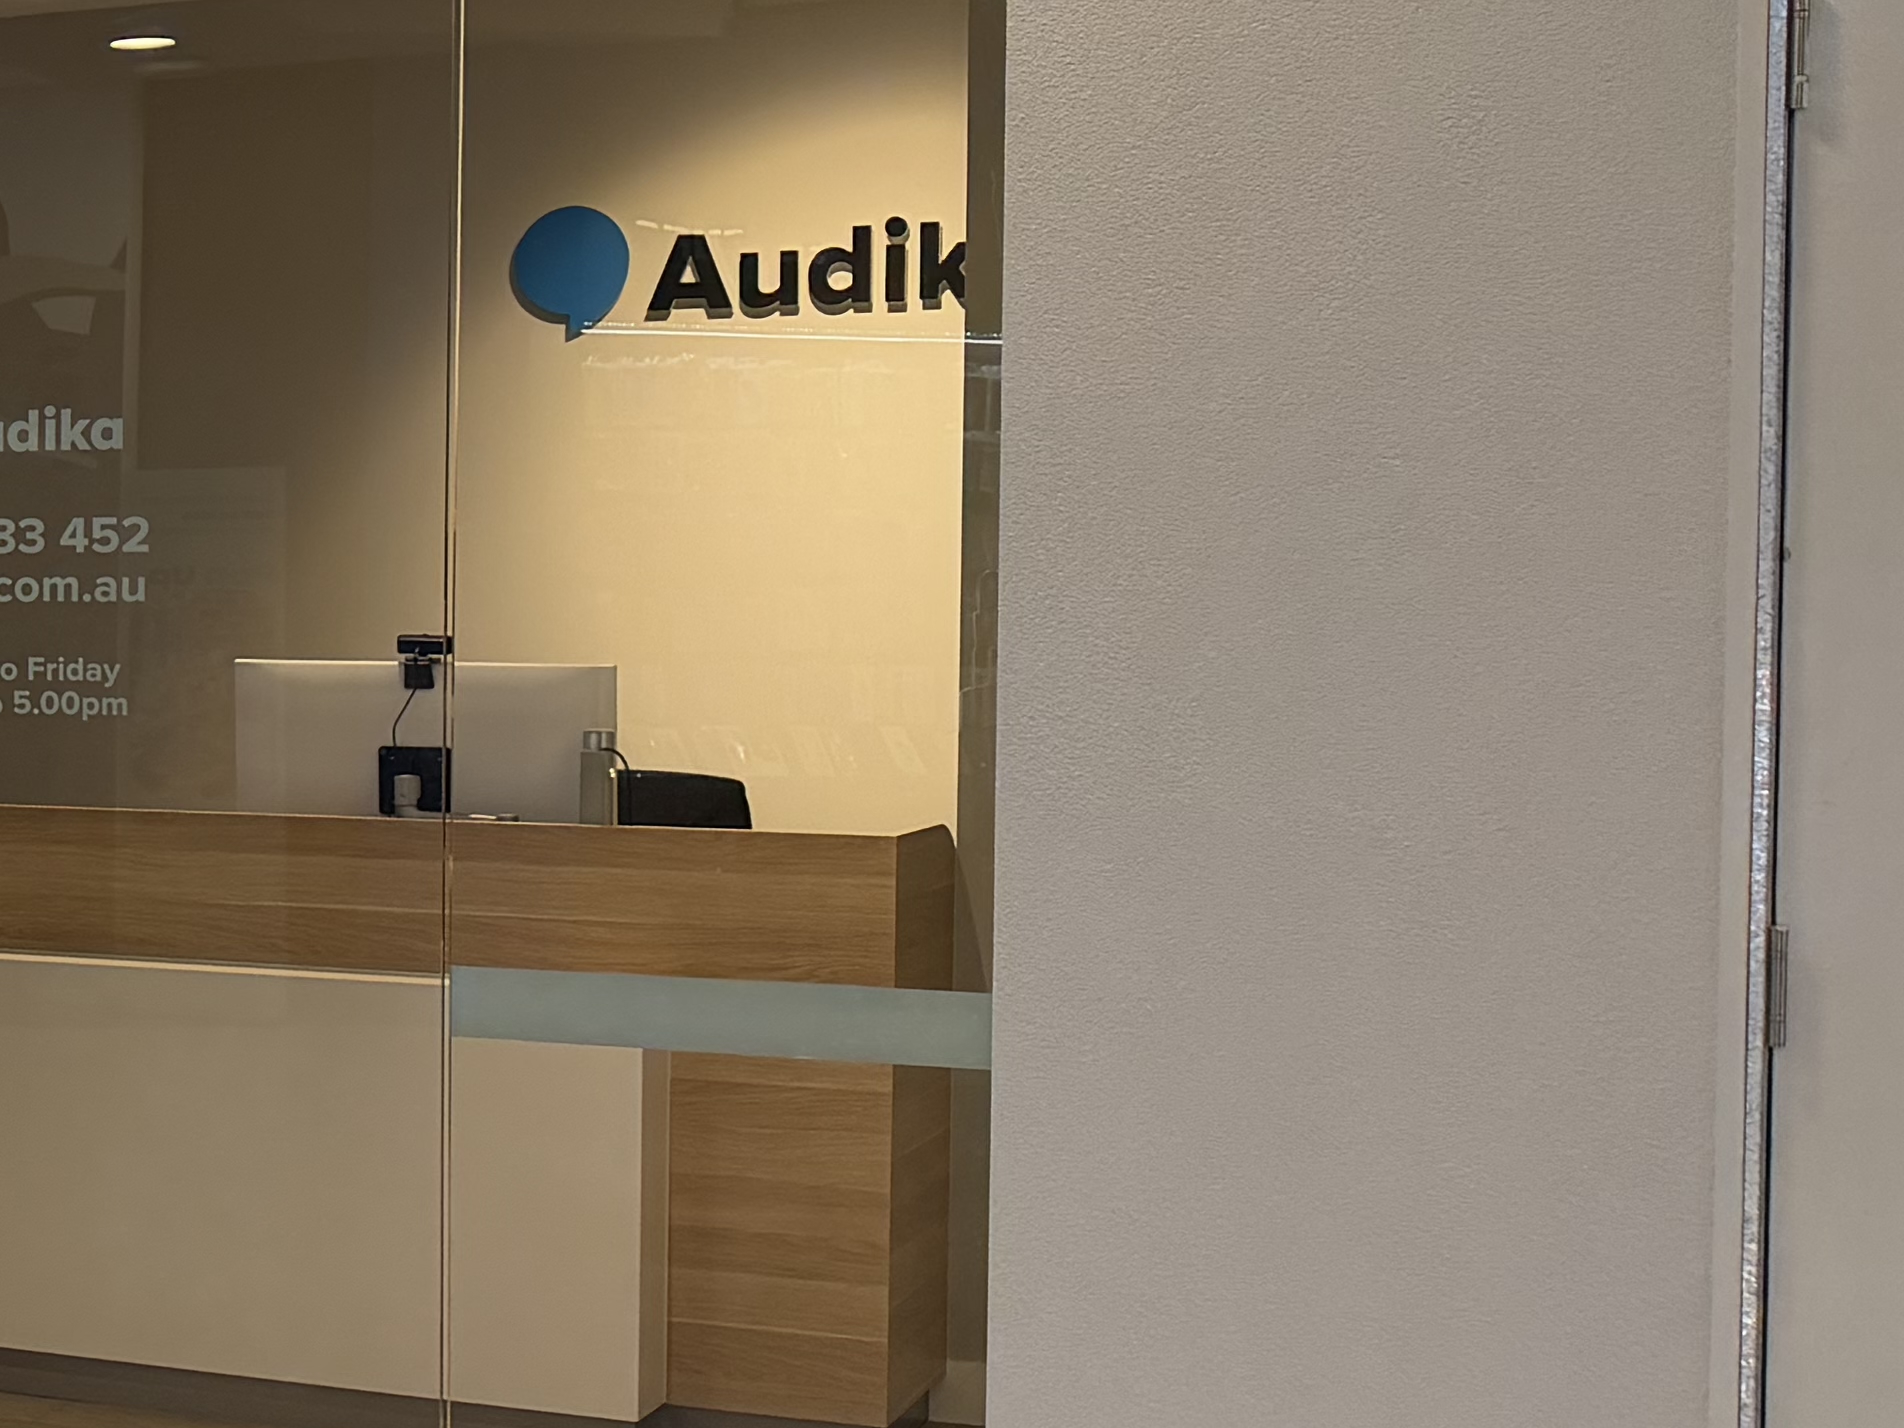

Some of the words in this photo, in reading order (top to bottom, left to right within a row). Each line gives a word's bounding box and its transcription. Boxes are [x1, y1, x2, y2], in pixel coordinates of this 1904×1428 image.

[644, 216, 967, 319] Audik
[59, 516, 150, 553] 452
[27, 656, 121, 687] Friday
[13, 689, 128, 721] 5.00pm
